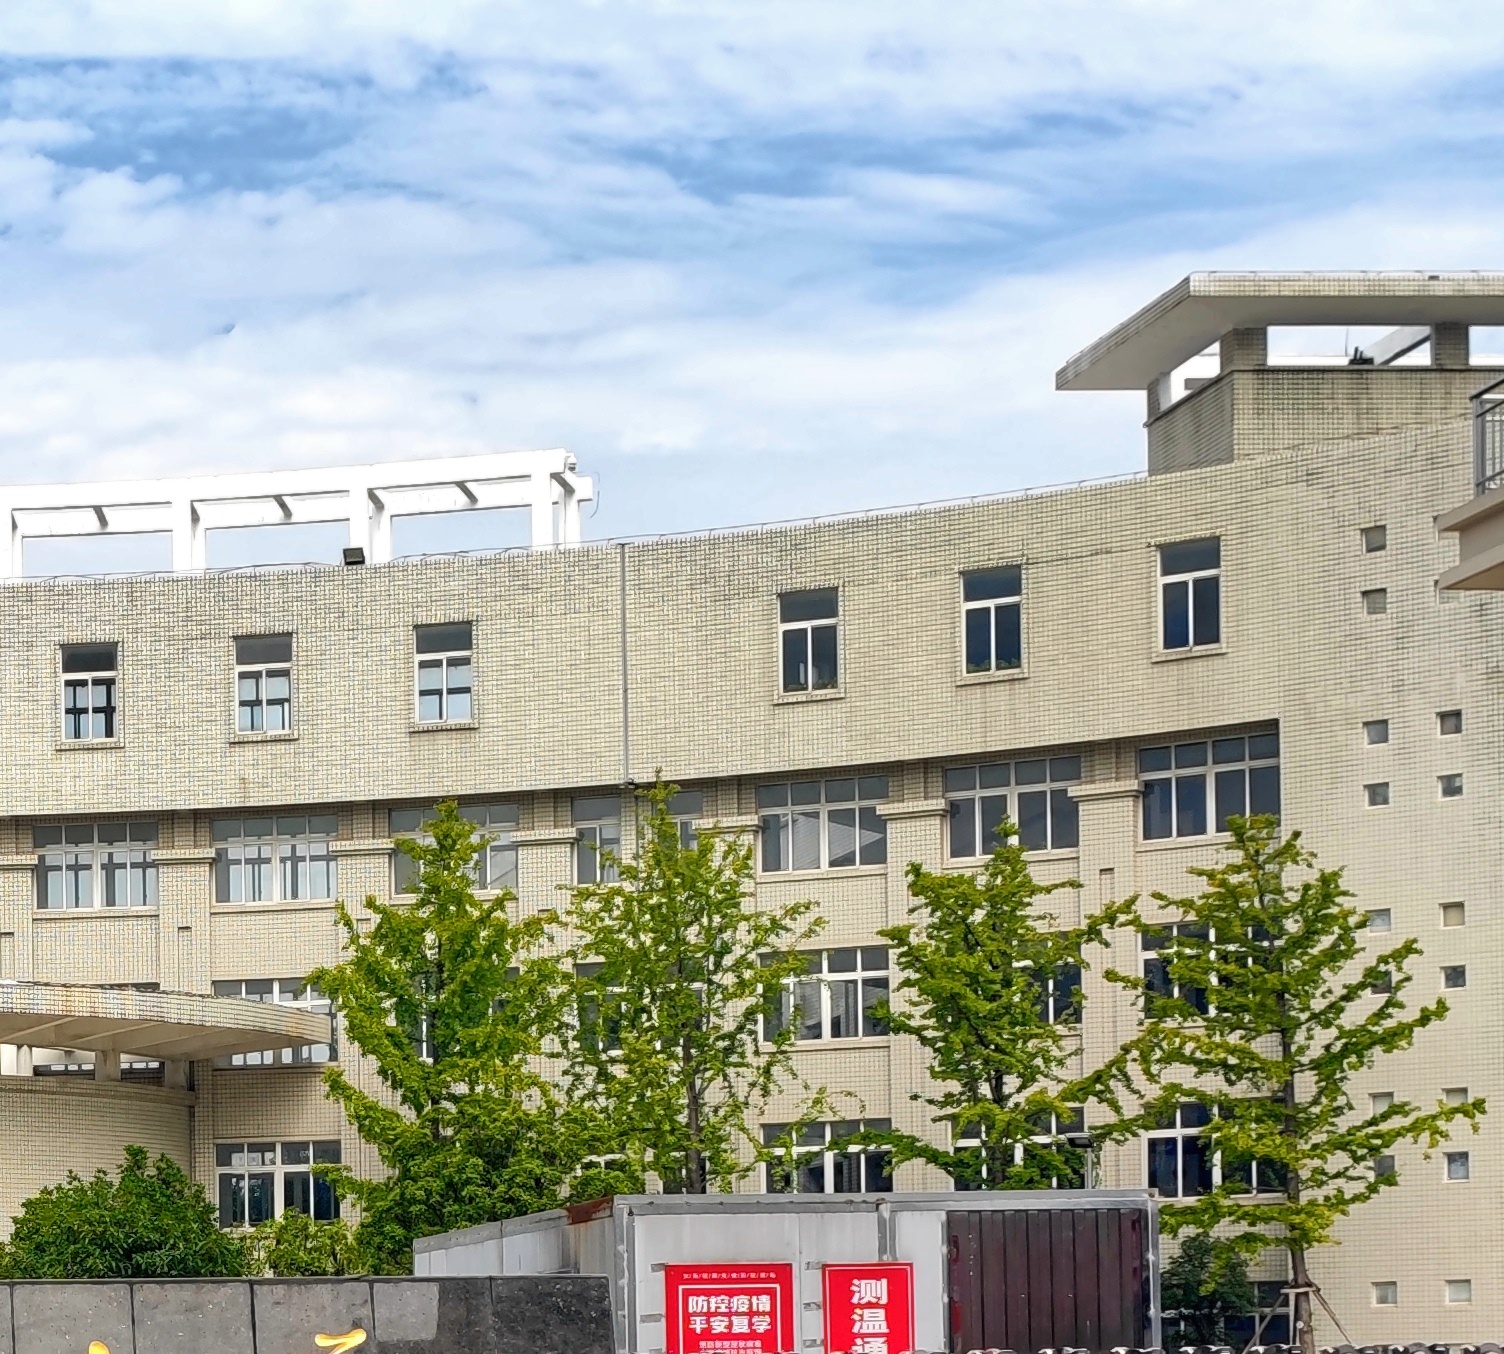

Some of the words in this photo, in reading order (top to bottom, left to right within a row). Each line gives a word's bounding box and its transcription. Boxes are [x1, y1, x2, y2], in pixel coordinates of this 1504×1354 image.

[688, 1295, 771, 1313] 防控疫情
[689, 1315, 771, 1334] 平安复学
